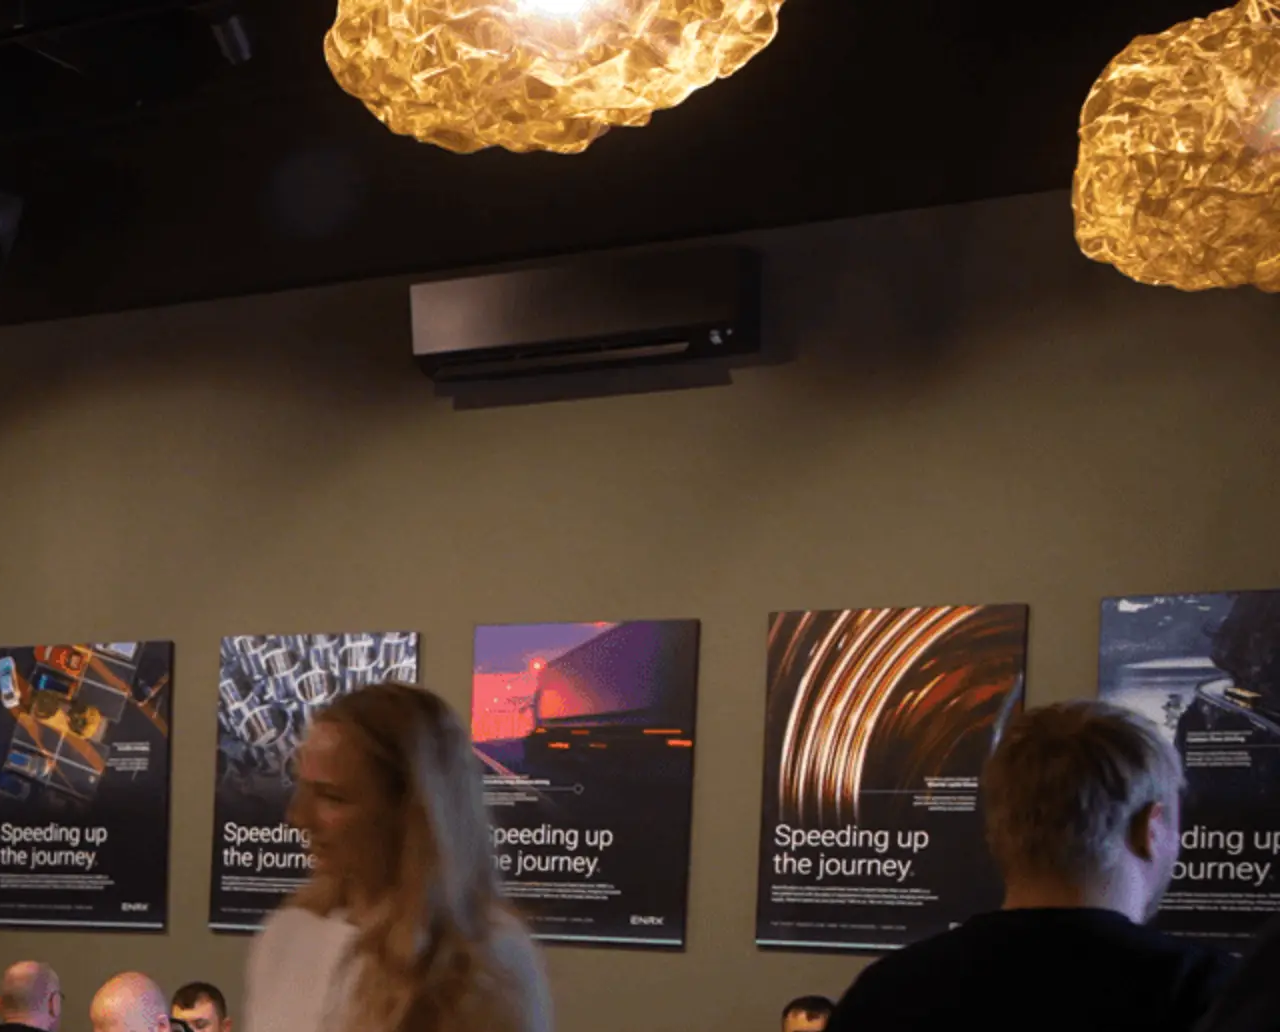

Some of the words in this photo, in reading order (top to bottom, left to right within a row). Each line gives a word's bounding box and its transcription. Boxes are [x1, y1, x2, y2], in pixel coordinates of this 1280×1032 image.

[0, 823, 80, 847] Speeding
[85, 827, 108, 846] up
[223, 822, 312, 848] Speeding
[488, 823, 579, 850] peeding
[585, 829, 614, 852] up
[774, 824, 890, 854] Speeding
[897, 830, 930, 854] up
[1181, 825, 1244, 855] ding
[0, 847, 28, 865] the
[222, 847, 254, 867] the
[256, 848, 318, 872] journe
[773, 852, 812, 875] the
[629, 915, 664, 926] ENRX
